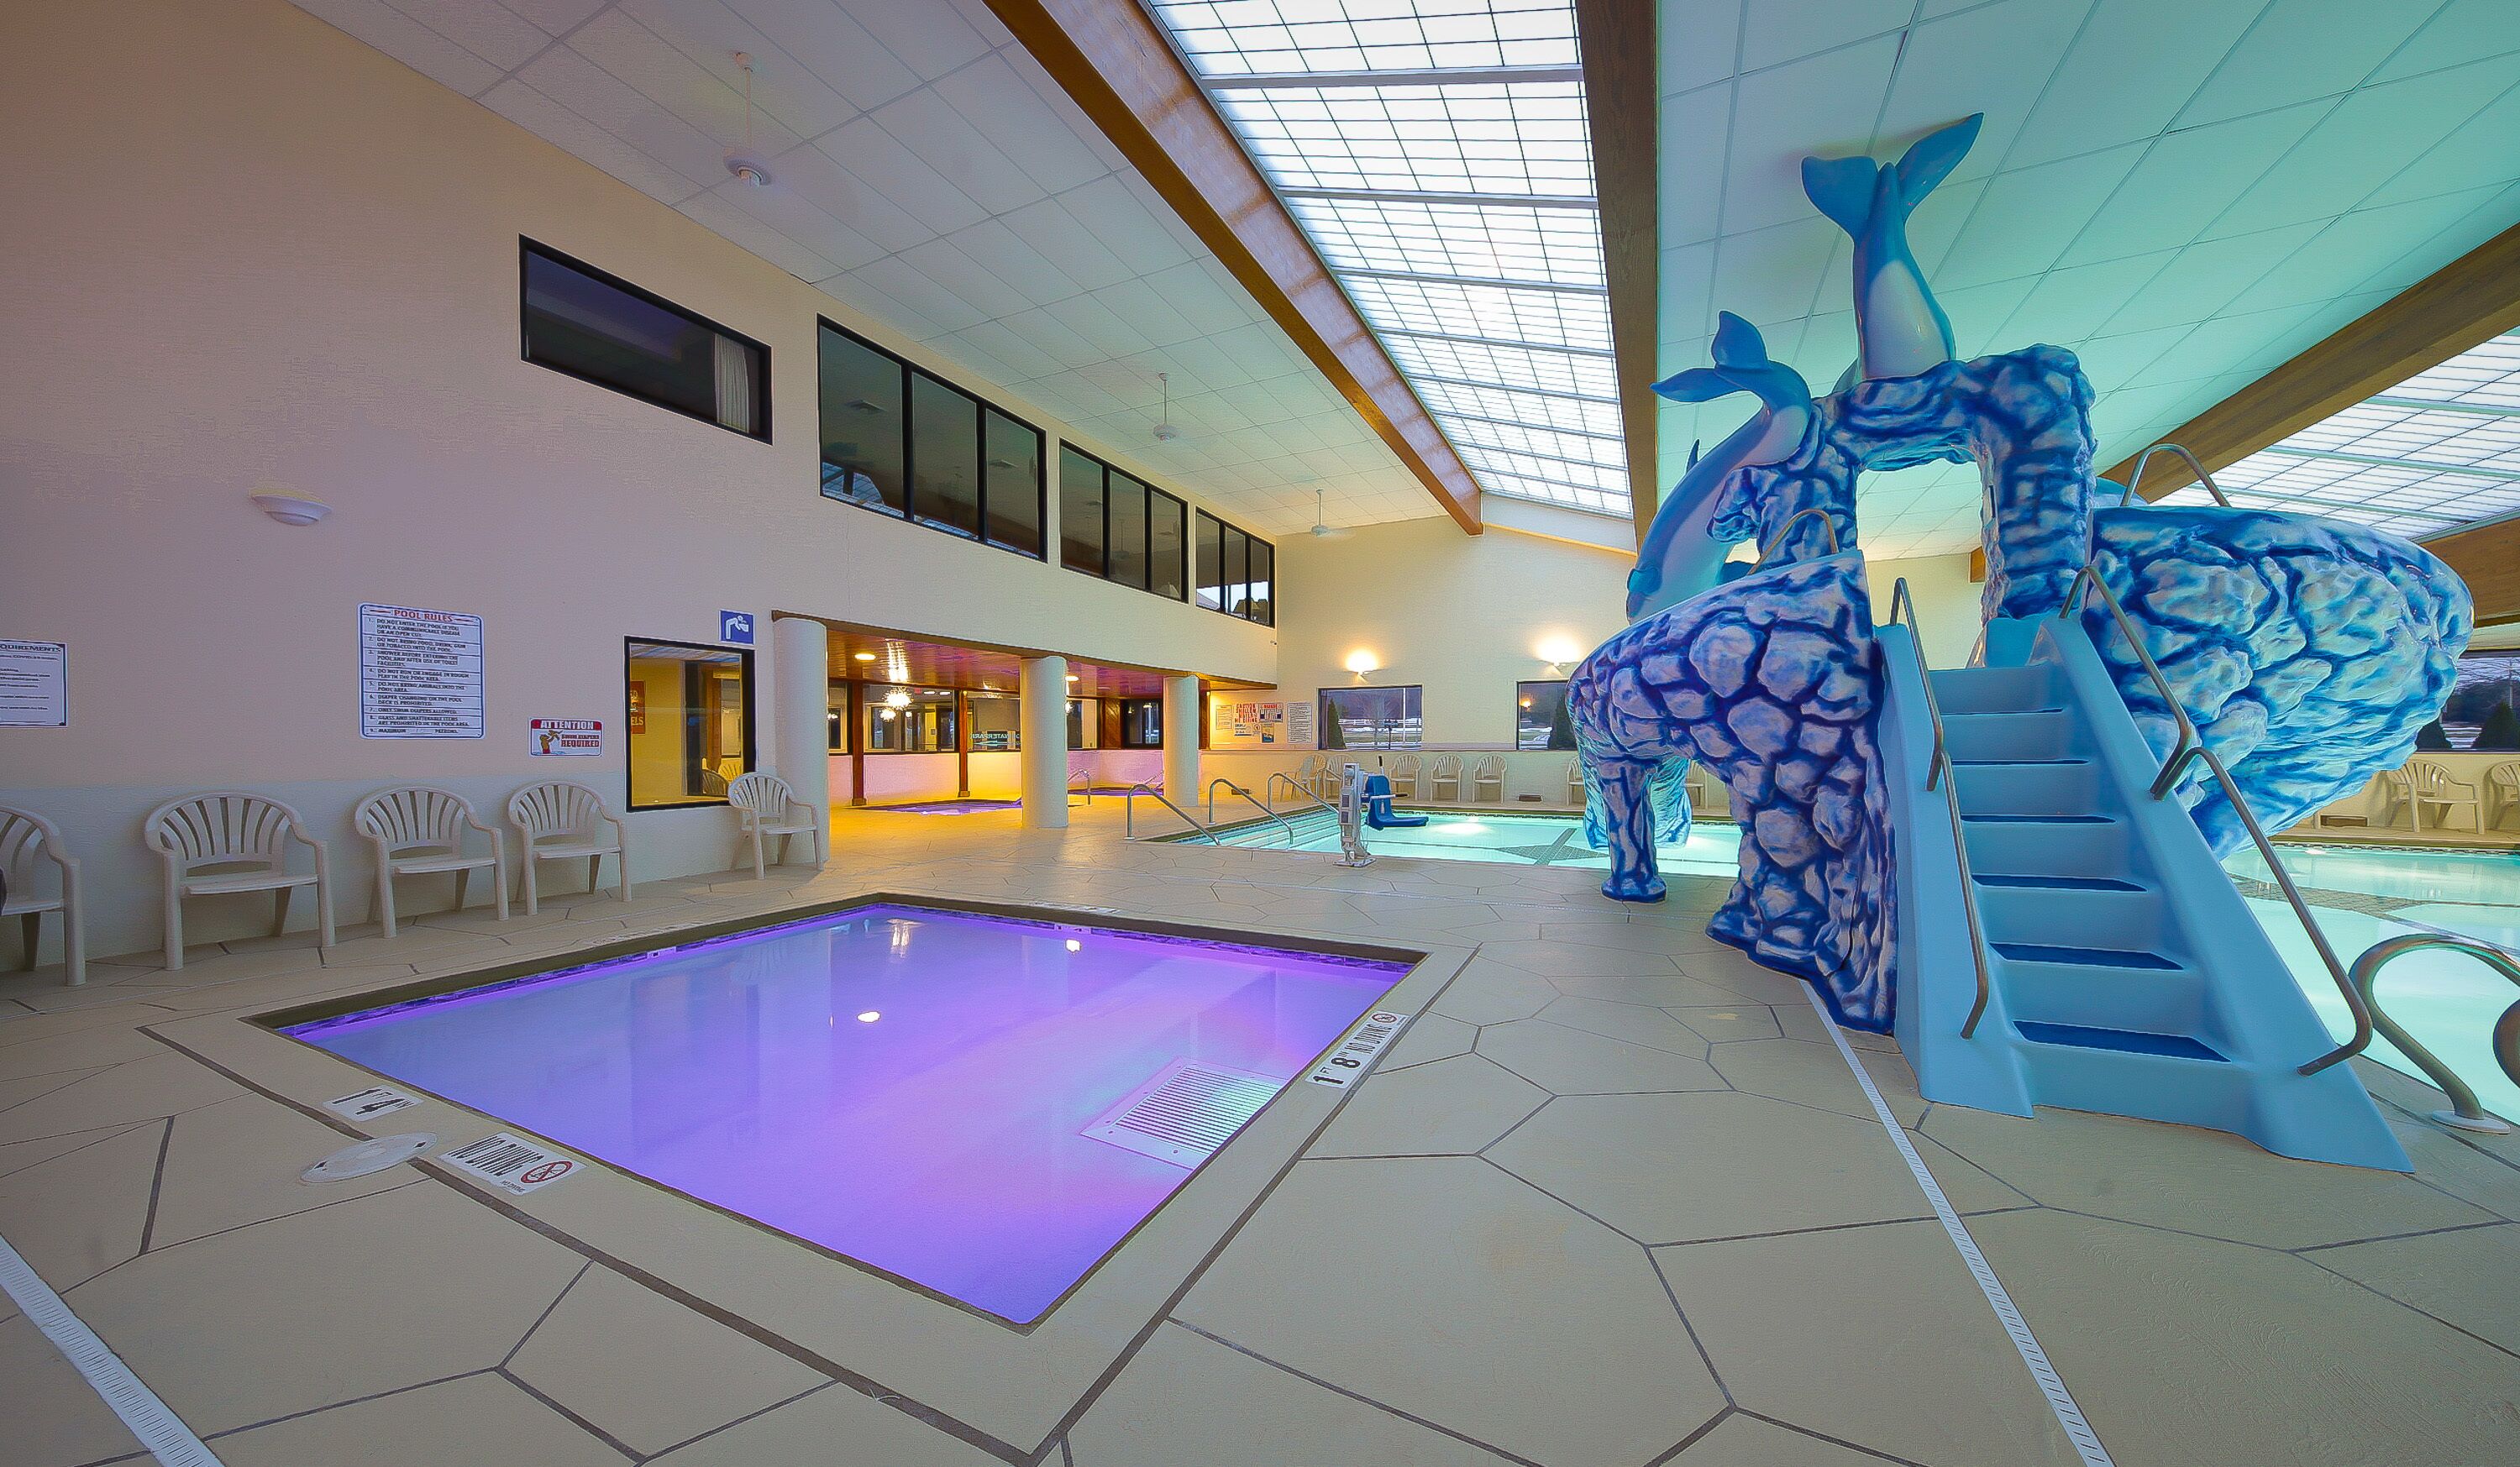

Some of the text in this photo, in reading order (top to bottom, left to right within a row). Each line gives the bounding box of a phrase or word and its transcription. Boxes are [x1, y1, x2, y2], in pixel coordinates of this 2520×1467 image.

[394, 610, 452, 621] POOL RULES
[540, 720, 594, 730] ATTENTION
[1353, 1024, 1393, 1044] DIVING
[1345, 1042, 1375, 1055] NO
[1331, 1057, 1361, 1068] 8
[1320, 1066, 1332, 1075] FT
[1313, 1076, 1344, 1084] 1
[332, 1089, 382, 1104] 1
[355, 1098, 405, 1115] 4
[448, 1136, 544, 1176] NO DIVING
